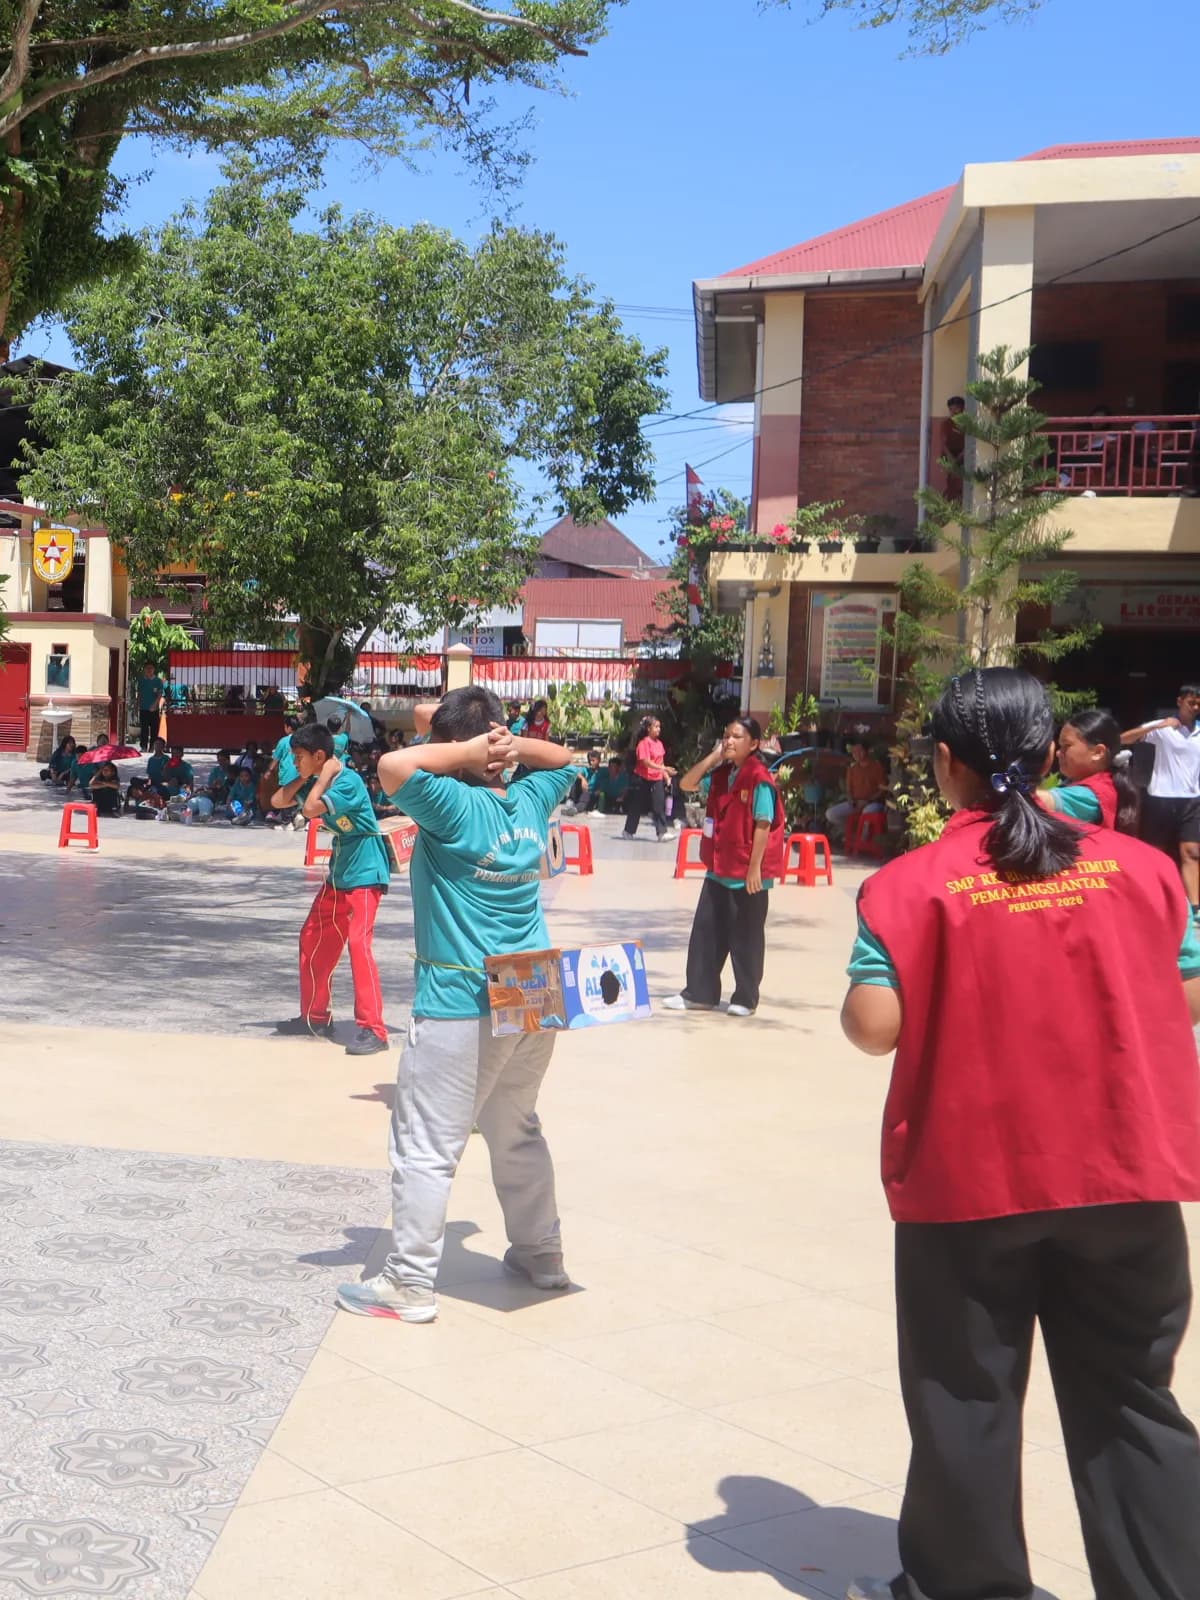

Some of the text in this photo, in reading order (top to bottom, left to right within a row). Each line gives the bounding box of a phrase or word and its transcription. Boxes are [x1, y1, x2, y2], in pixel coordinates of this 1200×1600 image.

[461, 636, 495, 645] DETOX
[946, 876, 976, 895] SMP
[1075, 859, 1120, 875] TIMUR
[970, 877, 1109, 905] PEMATANGSIANTAR
[1008, 898, 1053, 913] PERIODE
[585, 971, 629, 998] ALN
